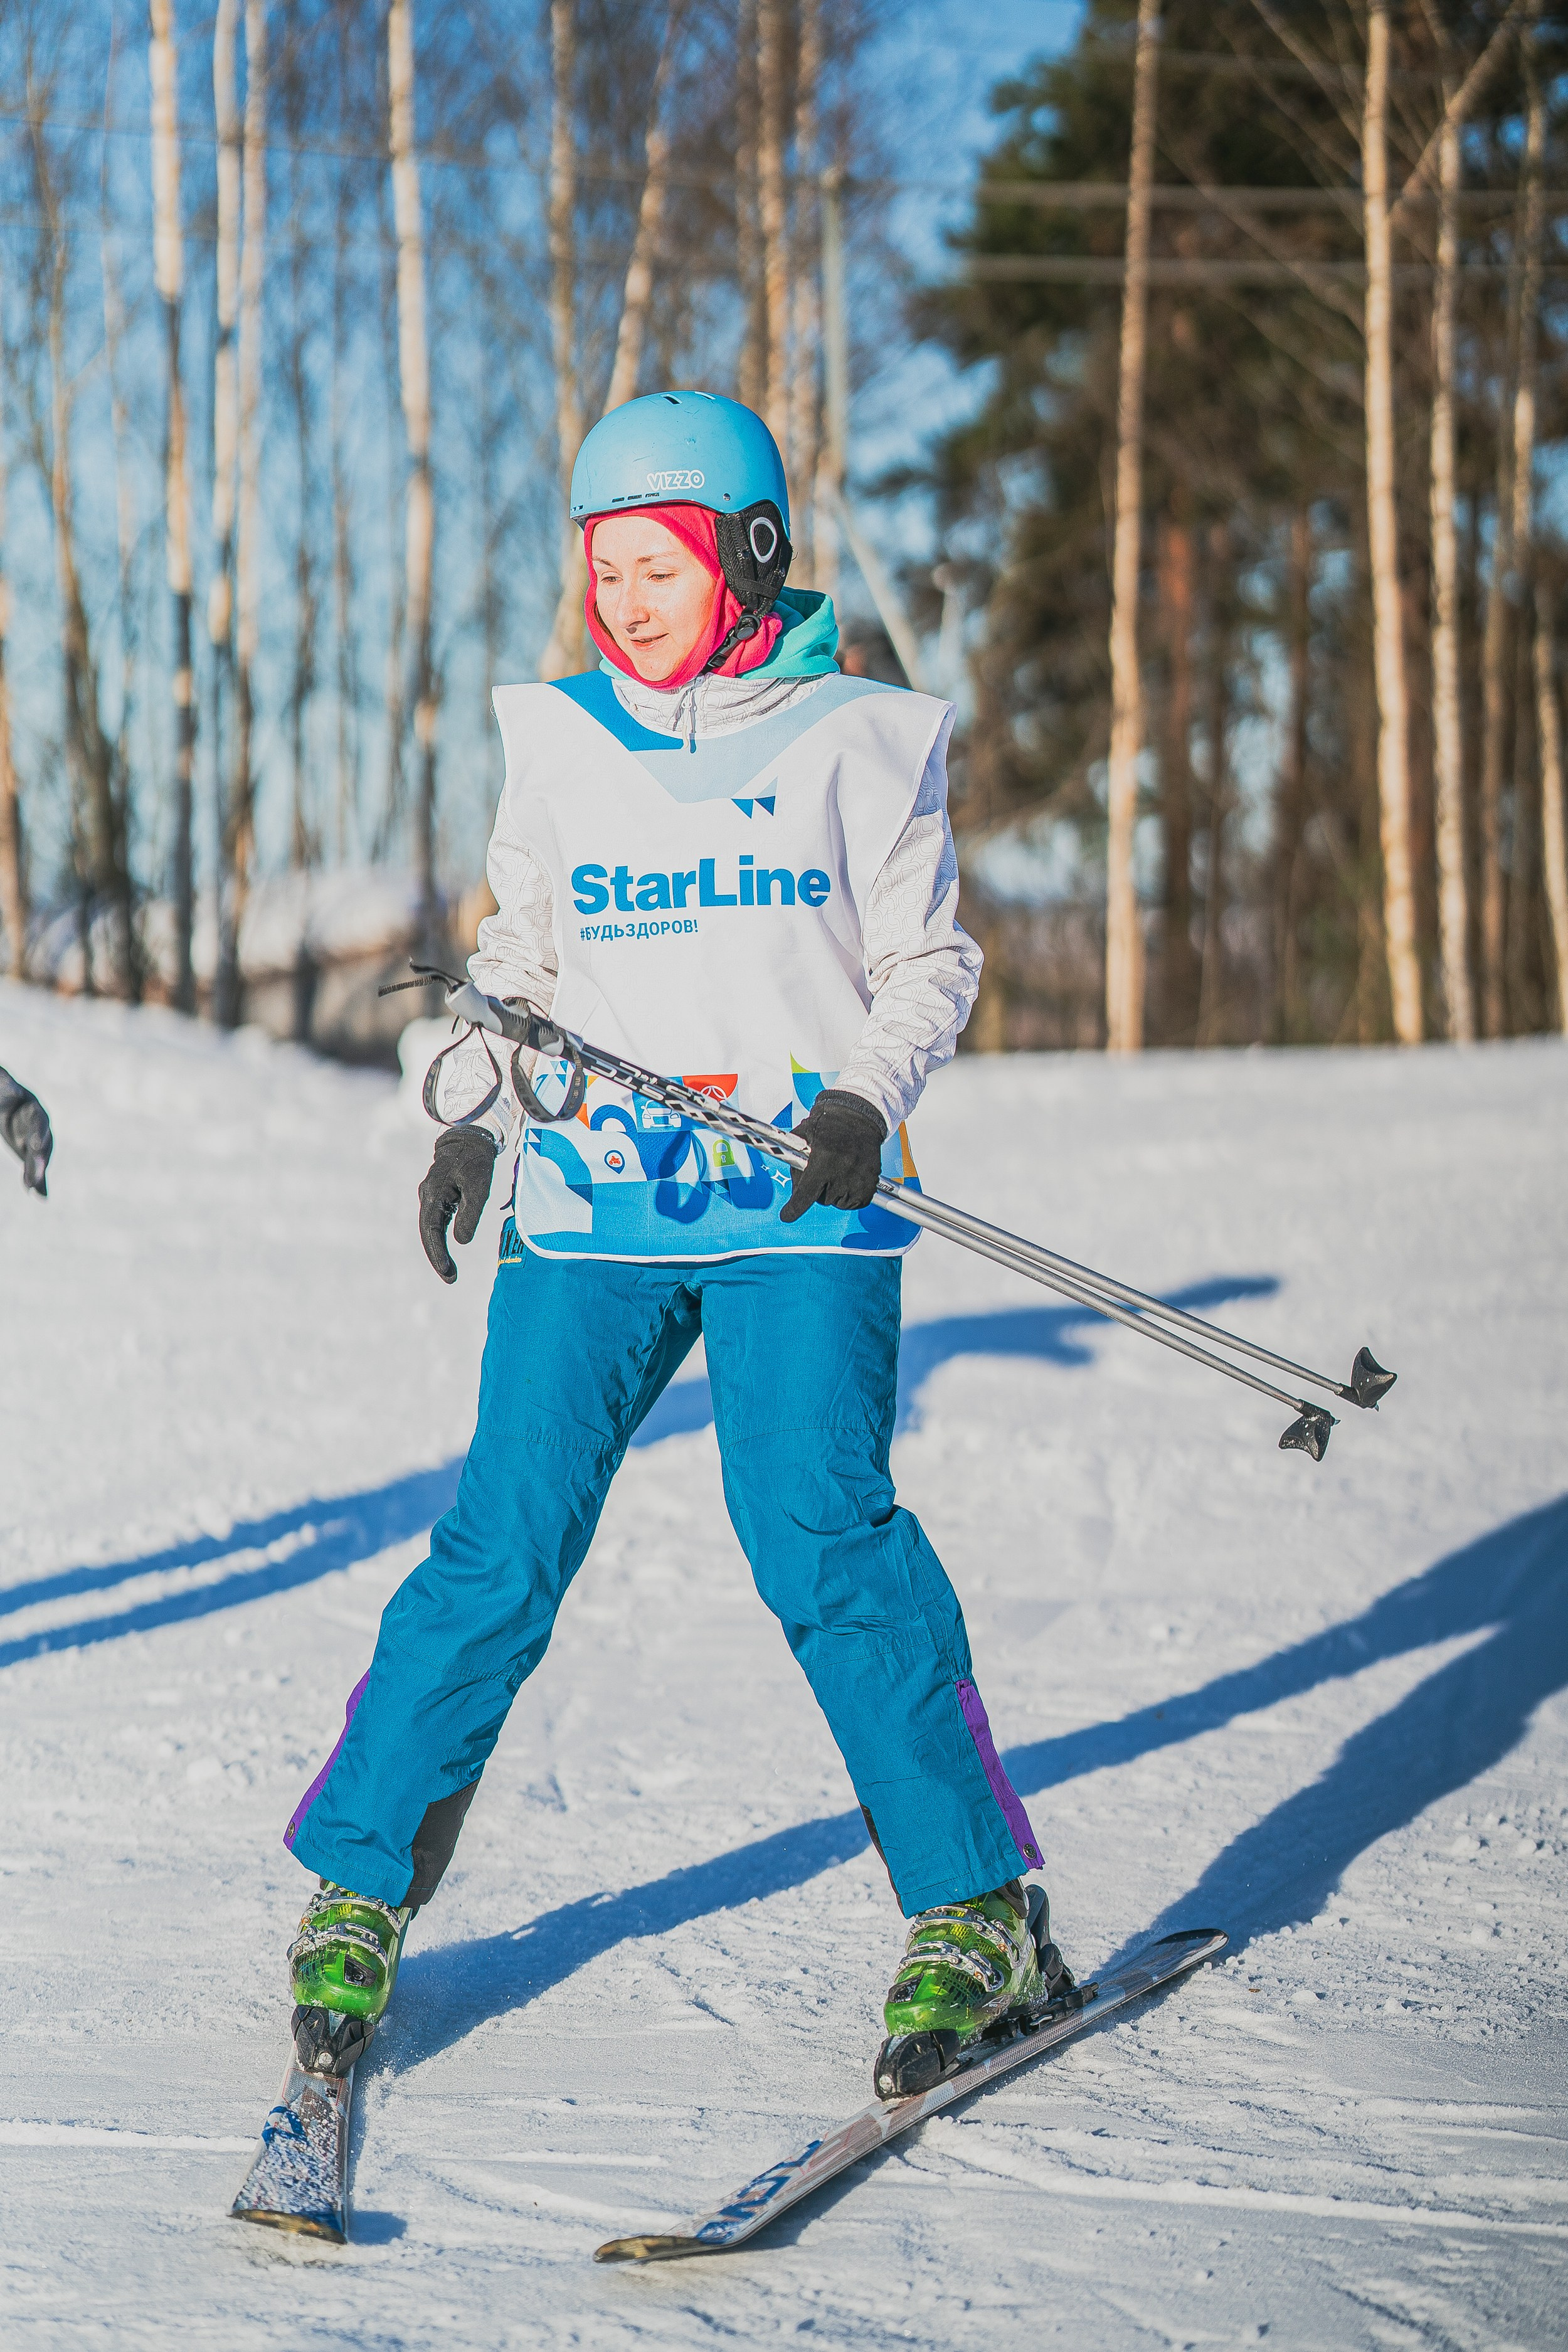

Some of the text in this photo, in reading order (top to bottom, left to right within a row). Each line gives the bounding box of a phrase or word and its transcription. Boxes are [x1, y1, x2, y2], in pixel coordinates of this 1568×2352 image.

[647, 469, 705, 491] VIZZO
[571, 855, 831, 915] StarLine
[580, 919, 699, 941] #БУДЬЗДОРОВ!
